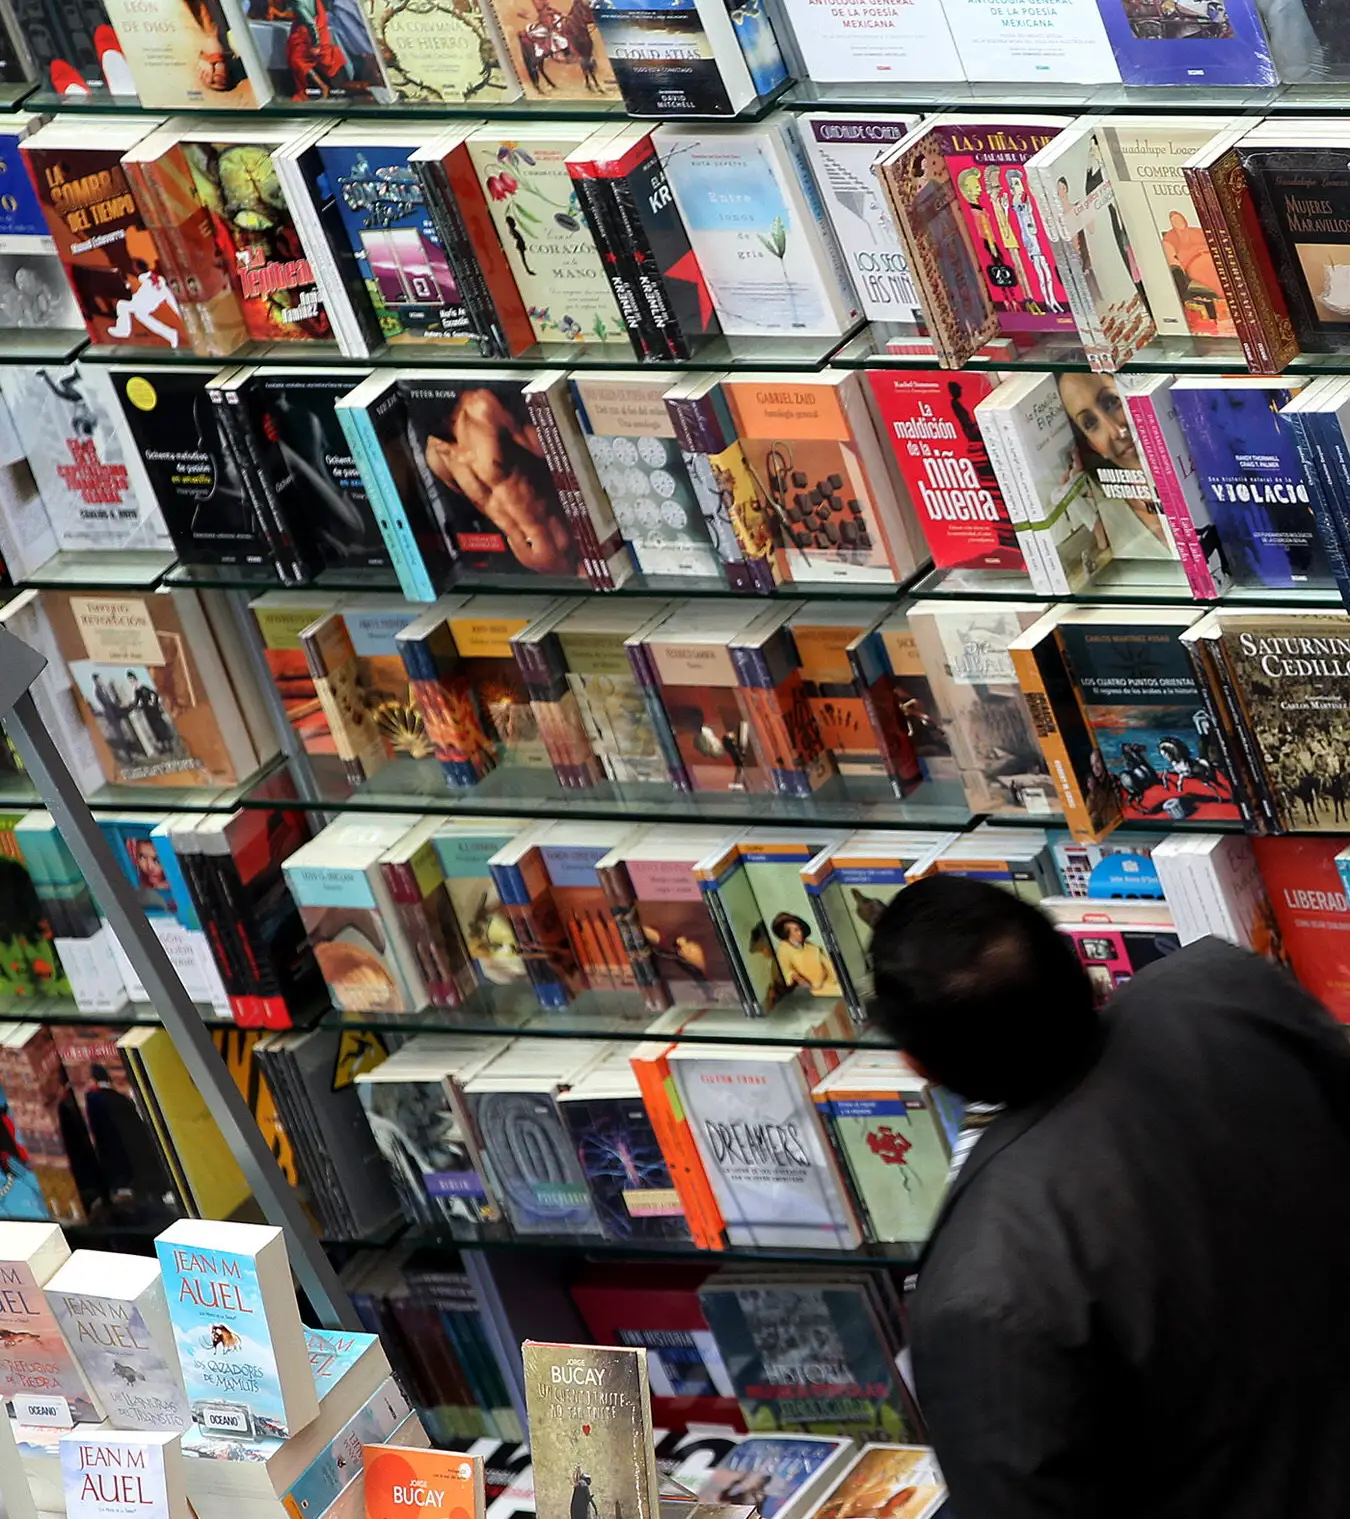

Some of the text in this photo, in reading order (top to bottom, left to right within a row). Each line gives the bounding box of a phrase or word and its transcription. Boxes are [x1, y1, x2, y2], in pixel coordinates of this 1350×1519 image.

[847, 8, 859, 16] LA
[843, 20, 894, 29] MEXICANA
[1285, 196, 1332, 215] MUJERES
[410, 390, 434, 398] PETER
[756, 392, 816, 405] GABRIEL ZAID
[919, 402, 932, 417] La
[893, 419, 956, 440] maldición
[907, 441, 930, 455] de la
[922, 452, 981, 489] niña
[919, 481, 999, 521] buena
[706, 1120, 811, 1168] DREAMERS
[173, 1250, 242, 1279] JEAN M
[180, 1278, 252, 1314] AUEL
[551, 1366, 605, 1385] BUCAY
[209, 1413, 239, 1427] OCEANO
[392, 1486, 444, 1508] BUCAY
